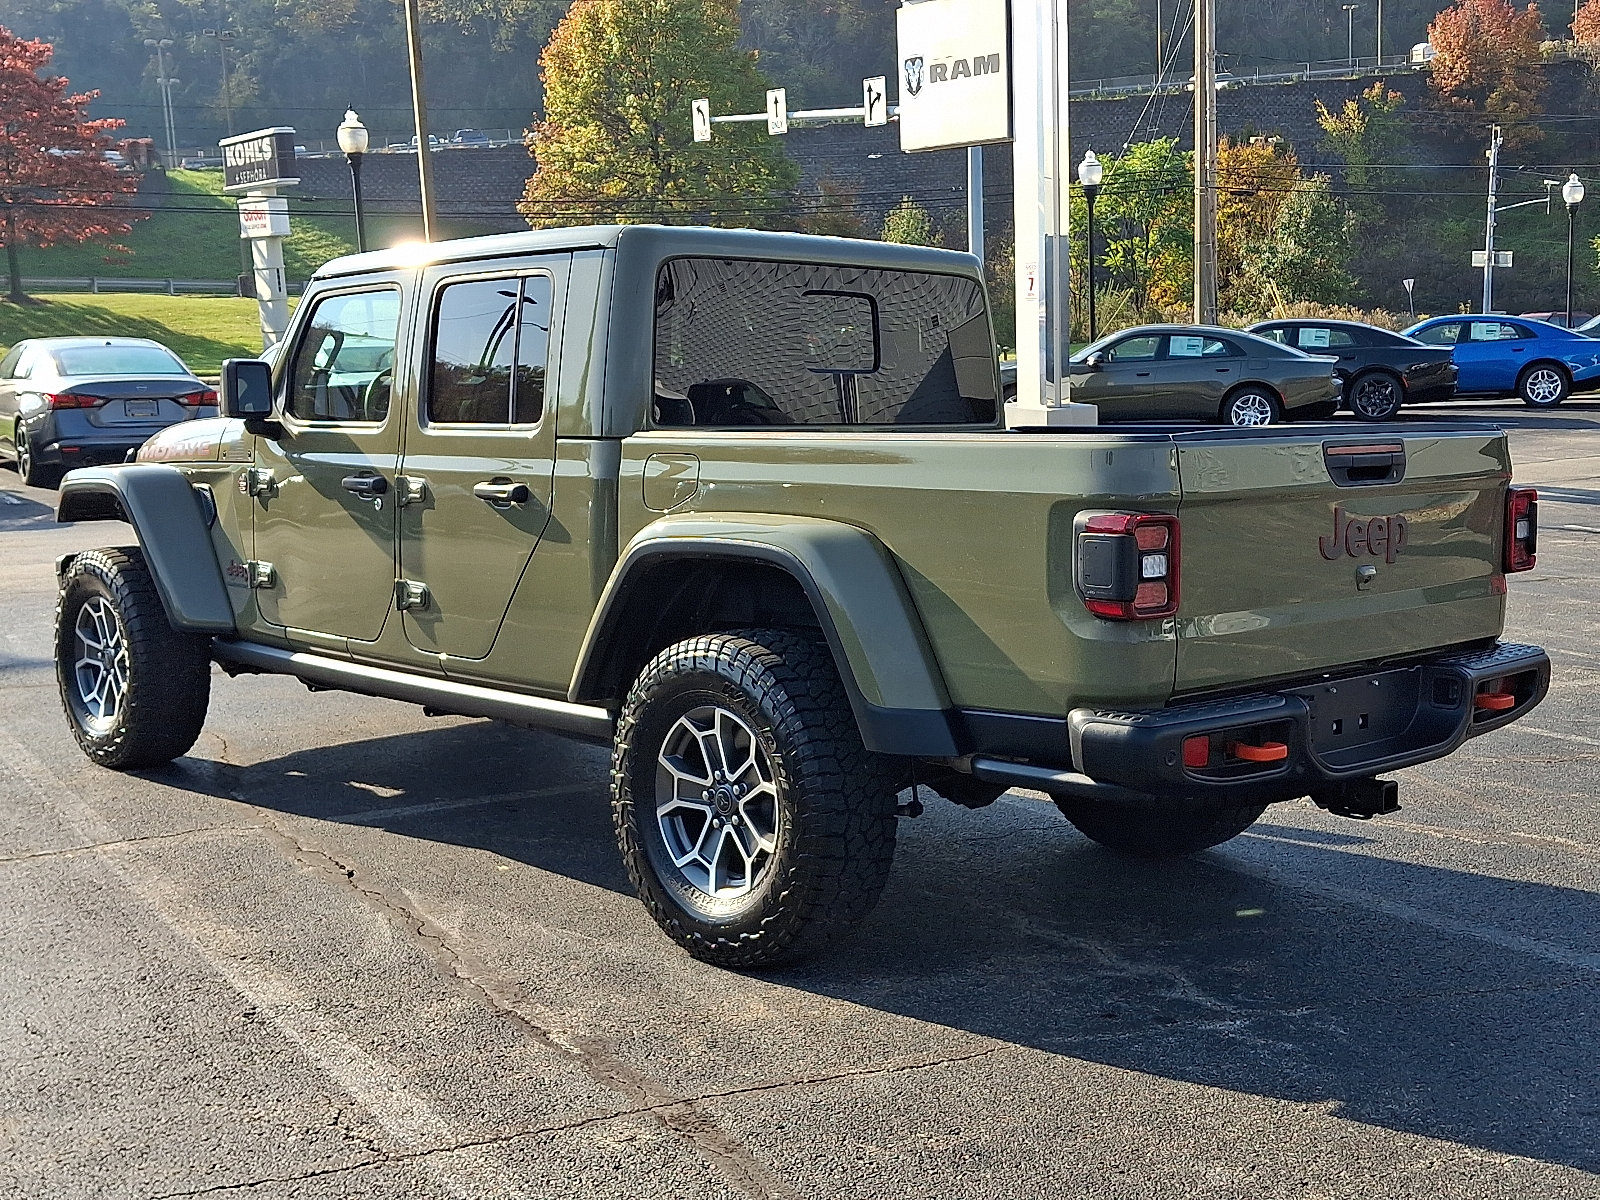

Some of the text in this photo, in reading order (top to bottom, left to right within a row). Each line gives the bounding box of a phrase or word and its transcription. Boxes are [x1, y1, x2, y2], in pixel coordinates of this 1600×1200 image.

[930, 53, 999, 83] RAM
[225, 137, 272, 167] KOHL'S
[1028, 277, 1034, 291] 7
[139, 441, 210, 459] MOJAVE
[1318, 507, 1409, 564] Jeep
